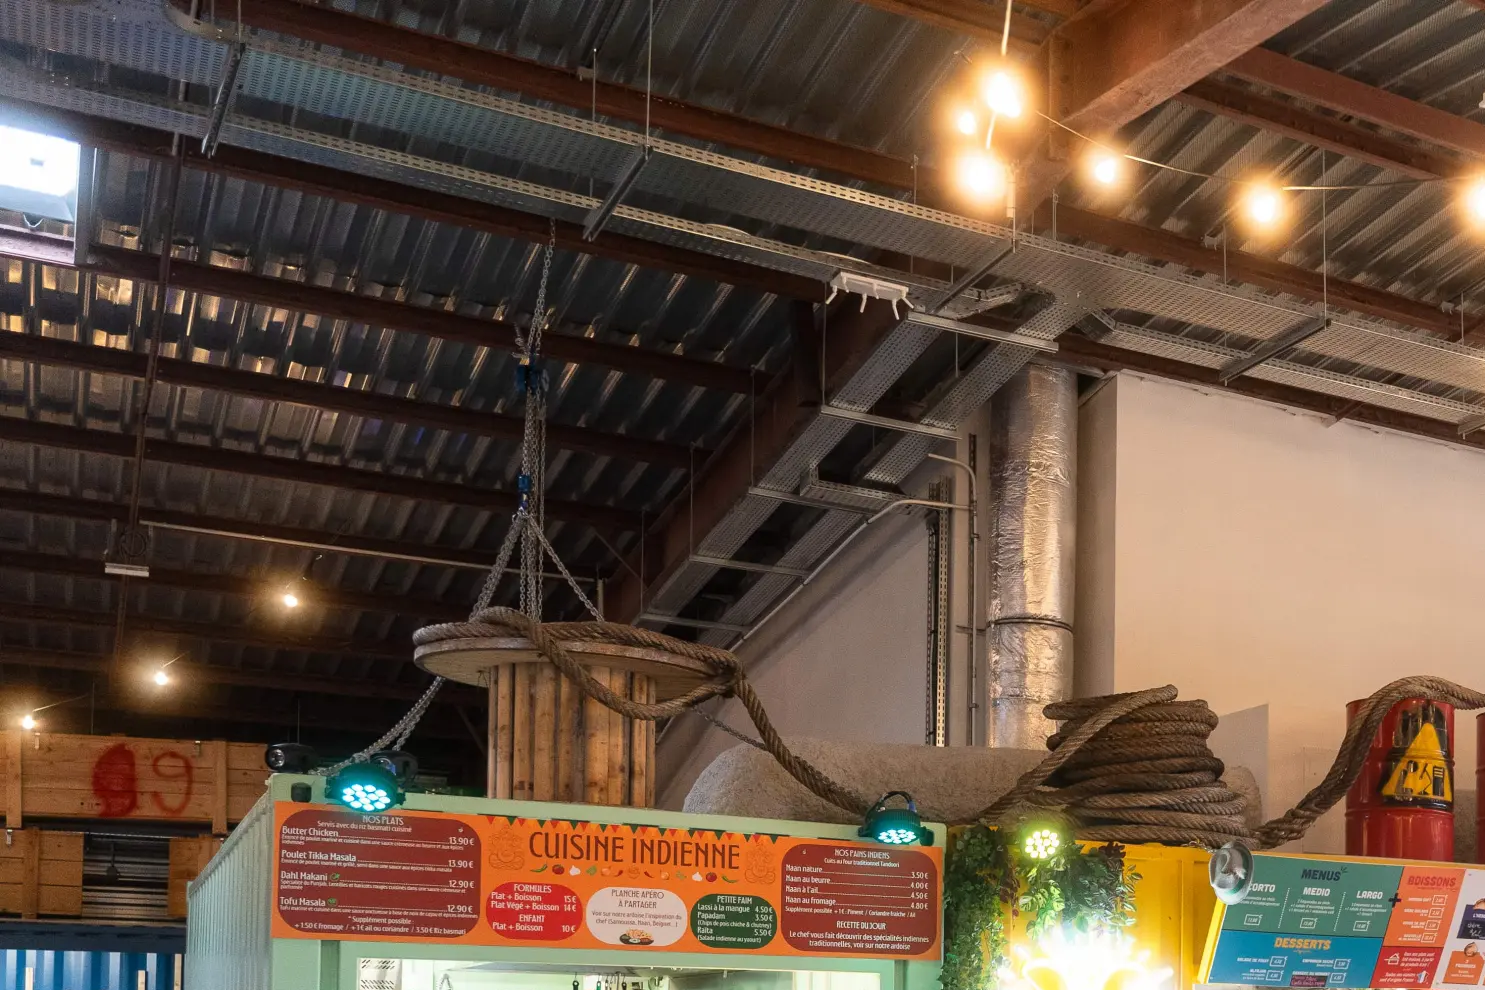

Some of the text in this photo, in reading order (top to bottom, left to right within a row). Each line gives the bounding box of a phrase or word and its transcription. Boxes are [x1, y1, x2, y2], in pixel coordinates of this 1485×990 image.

[317, 820, 335, 828] Servis
[363, 815, 404, 826] NOS PLATS
[282, 826, 339, 837] Butter Chicken
[529, 831, 740, 869] CUISINE INDIENNE
[835, 848, 890, 860] NOS PAINS INDIENS
[281, 850, 356, 862] Poulet Tikka Masala
[786, 864, 823, 873] Naan nature
[880, 860, 900, 868] Tandoori
[281, 871, 328, 881] Dahl Makani
[1301, 868, 1341, 881] MENUS
[811, 876, 830, 884] beurre
[1408, 876, 1456, 887] BOISSONS
[514, 884, 552, 893] FORMULES
[786, 885, 801, 893] Naan
[1303, 887, 1330, 896] MEDIO
[491, 892, 505, 900] Plat
[514, 893, 541, 902] Boisson
[611, 889, 664, 900] PLANCHE APÉRO
[1356, 890, 1383, 899] LARGO
[280, 897, 326, 907] Tofu Masala
[717, 895, 752, 904] PETITE FAIM
[810, 896, 836, 906] fromage
[491, 901, 505, 909] Plat
[506, 902, 523, 911] Végé
[532, 903, 559, 912] Boisson
[624, 900, 657, 909] PARTAGER
[519, 914, 545, 923] ENFANT
[697, 912, 725, 920] Papadam
[319, 923, 343, 931] fromage
[492, 922, 506, 930] Plat
[515, 923, 543, 932] Boisson
[837, 921, 886, 930] RECETTE DU JOUR
[873, 934, 902, 943] spécialités
[1274, 937, 1331, 950] DESSERTS
